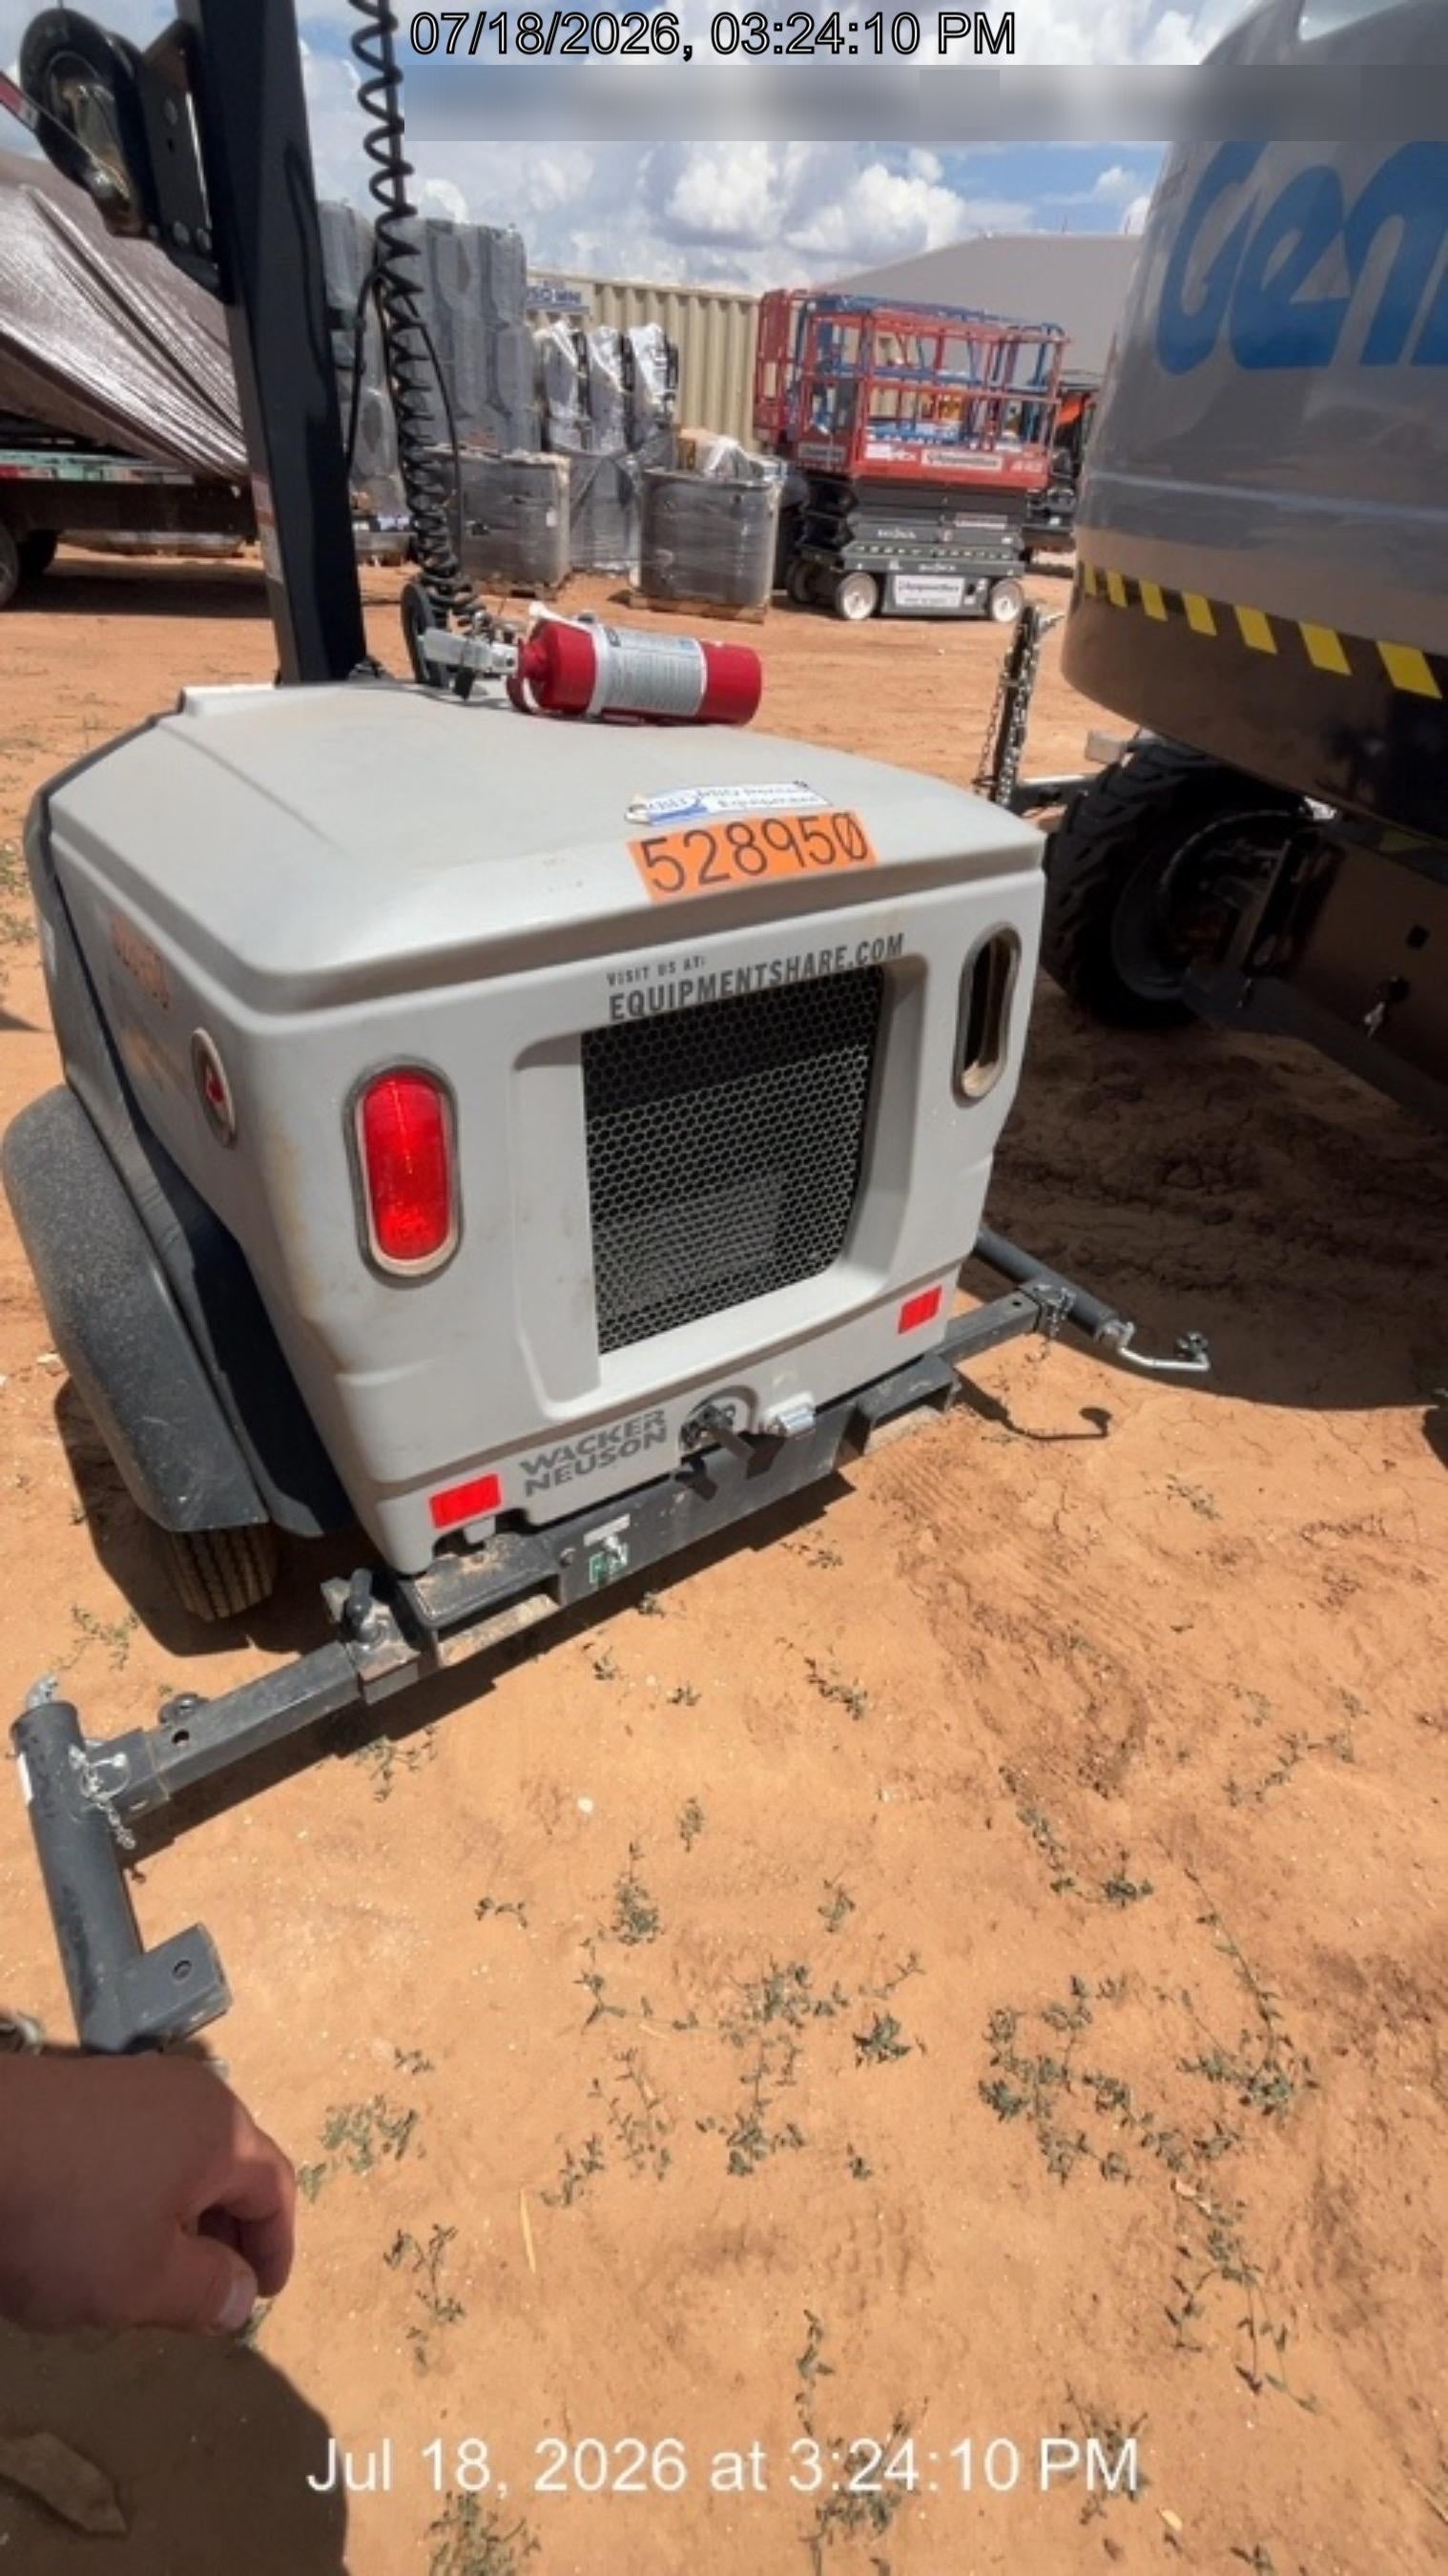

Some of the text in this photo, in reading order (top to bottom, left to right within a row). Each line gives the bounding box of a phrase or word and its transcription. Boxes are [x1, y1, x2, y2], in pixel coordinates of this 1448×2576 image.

[640, 812, 869, 893] 528950
[607, 966, 650, 987] VISIT
[658, 961, 676, 977] US
[609, 933, 904, 1021] EQUIPMENTSHARE.COM
[519, 1409, 665, 1476] WACKER
[525, 1425, 667, 1498] NEUSON
